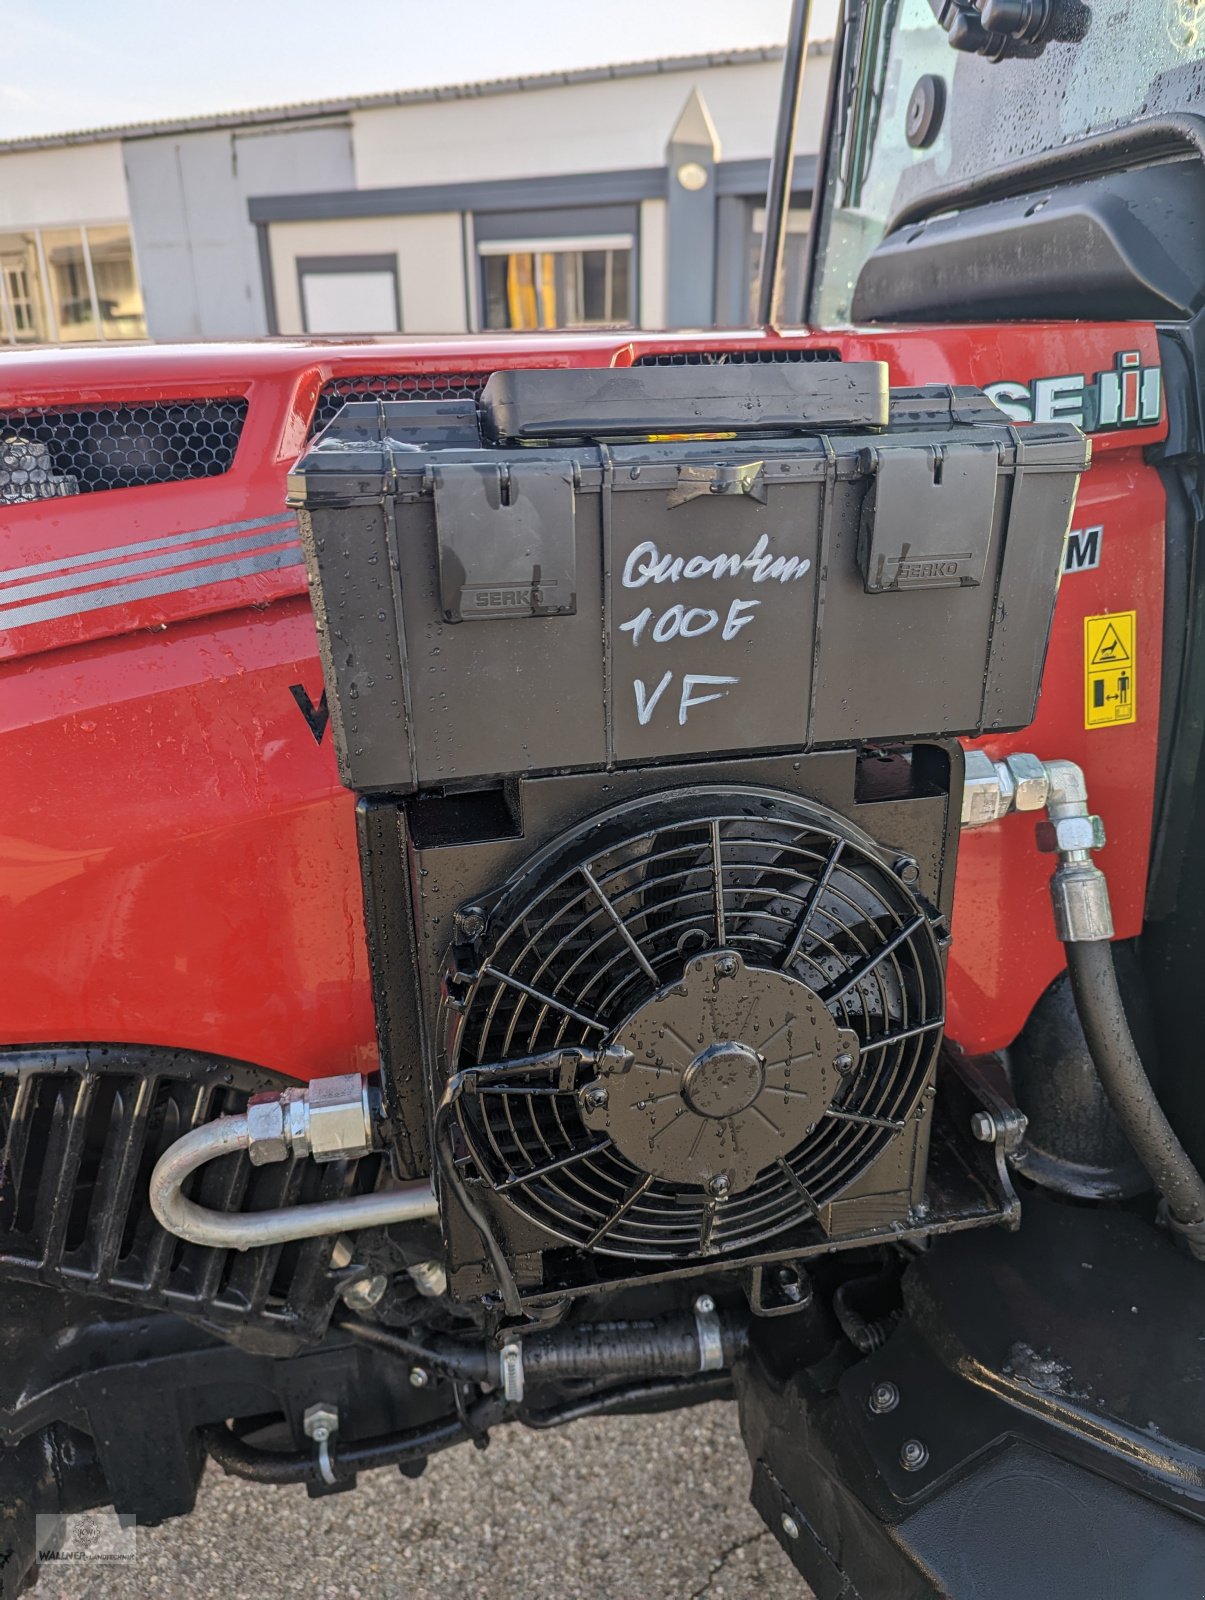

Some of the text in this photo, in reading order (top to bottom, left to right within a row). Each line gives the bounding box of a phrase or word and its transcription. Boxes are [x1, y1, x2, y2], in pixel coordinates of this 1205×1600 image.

[899, 562, 959, 580] SERKO
[475, 588, 545, 608] SERKO
[633, 669, 743, 726] VF
